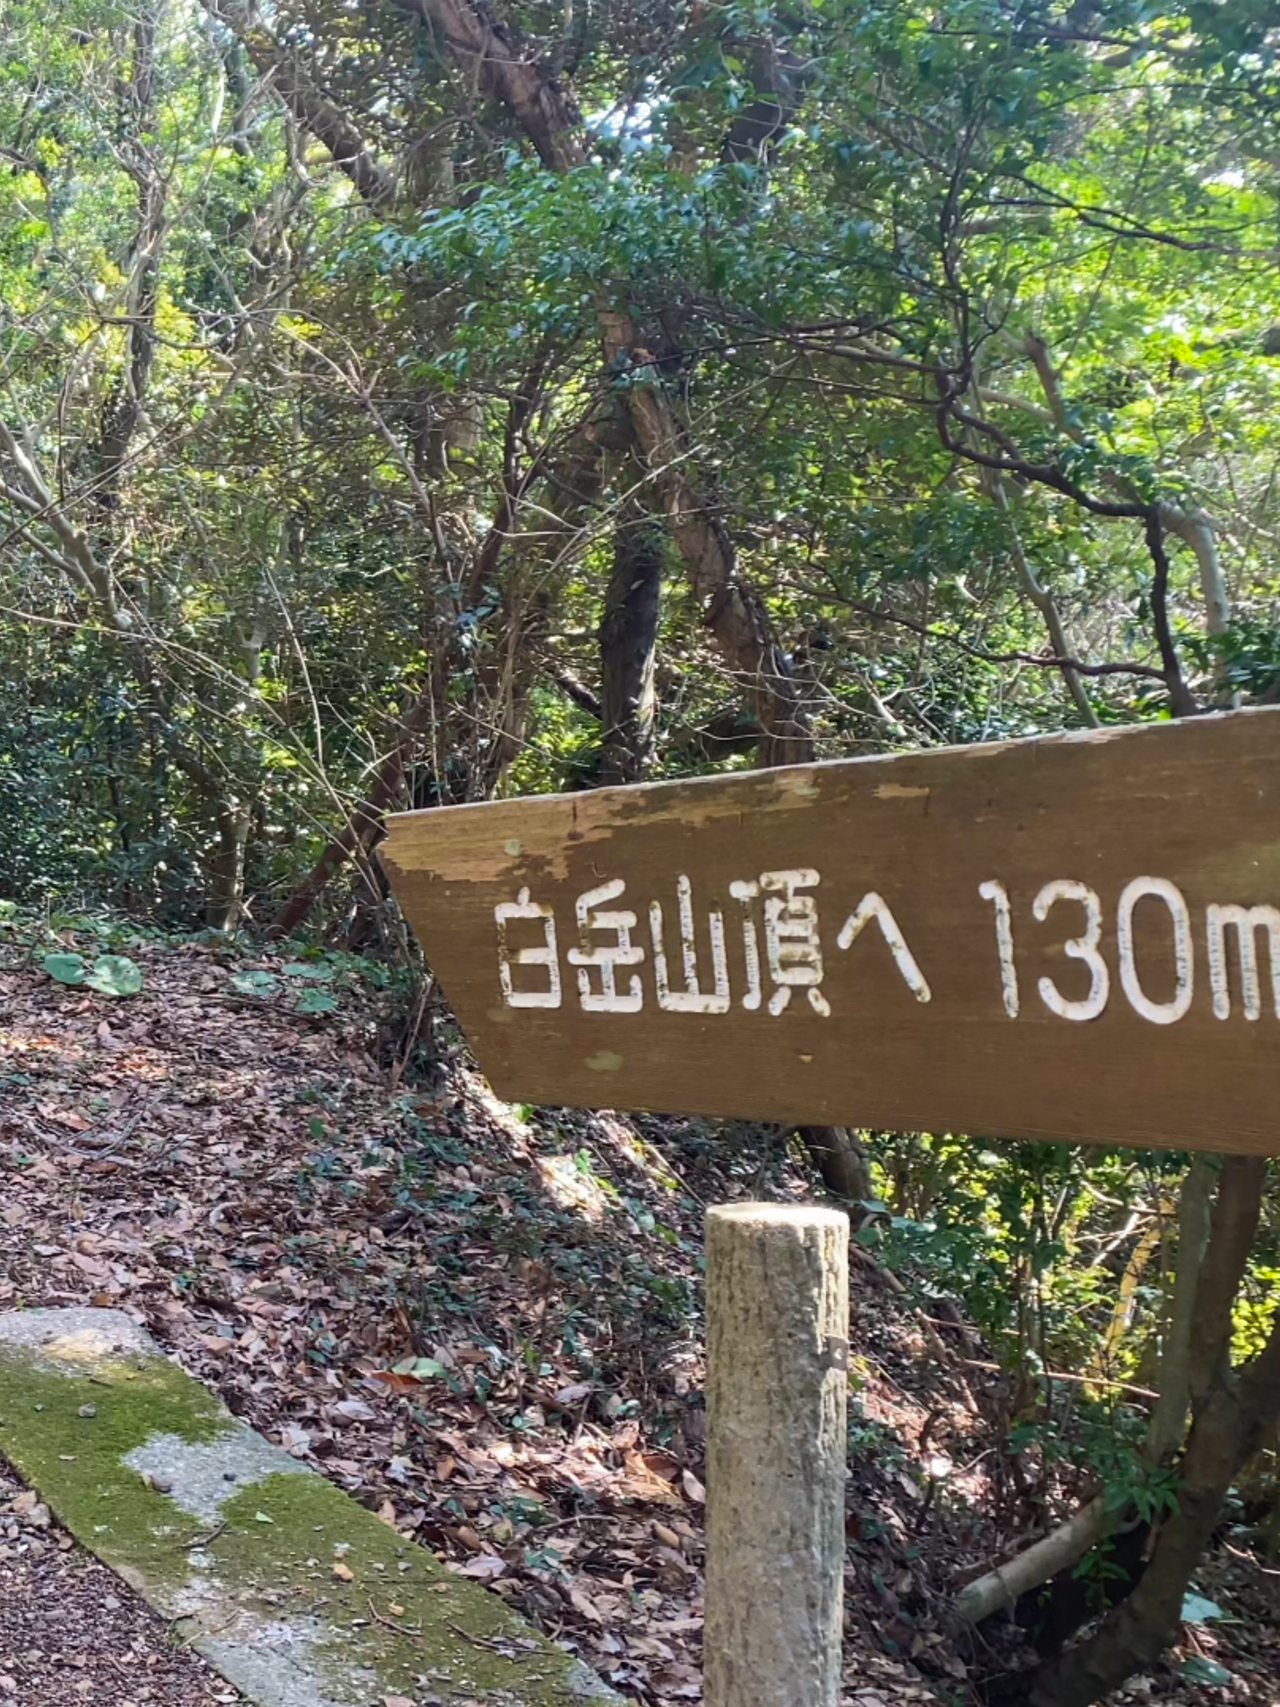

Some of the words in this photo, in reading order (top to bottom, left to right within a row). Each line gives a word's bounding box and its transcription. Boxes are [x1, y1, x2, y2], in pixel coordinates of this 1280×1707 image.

[494, 868, 931, 1018] 白岳山頂へ
[979, 876, 1280, 1024] 130m
